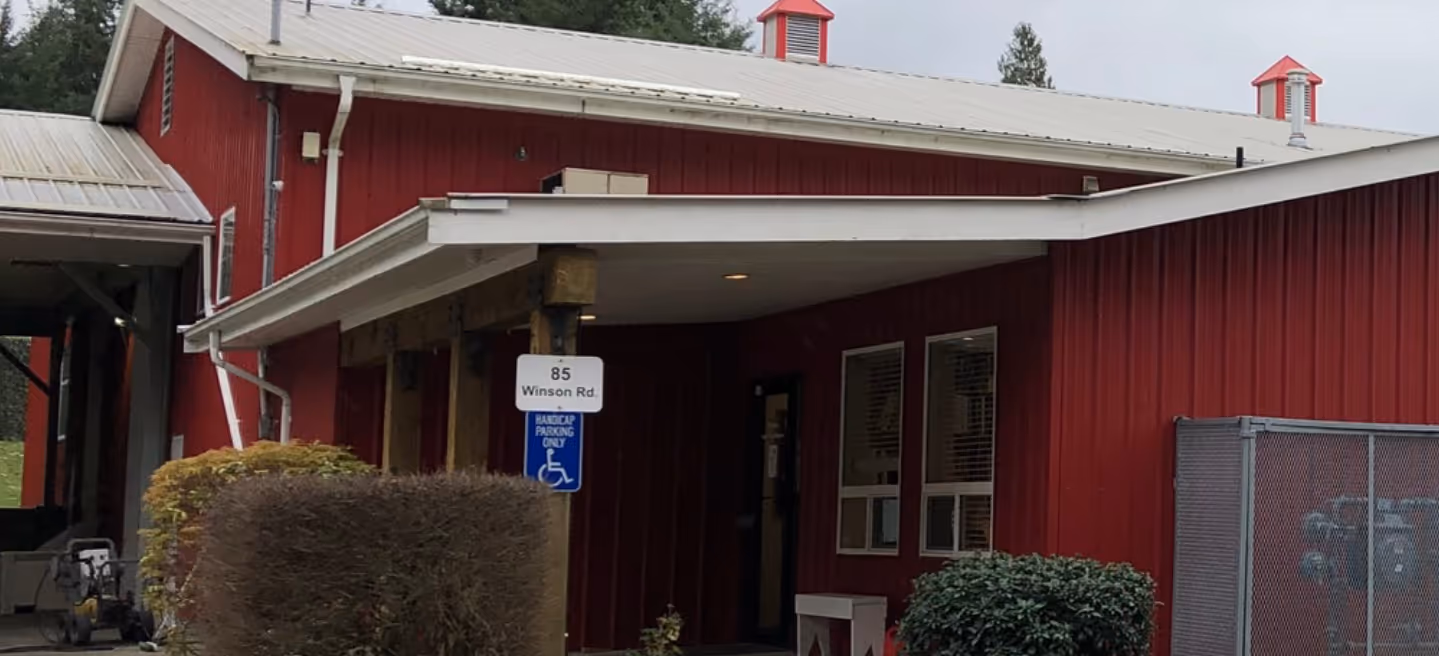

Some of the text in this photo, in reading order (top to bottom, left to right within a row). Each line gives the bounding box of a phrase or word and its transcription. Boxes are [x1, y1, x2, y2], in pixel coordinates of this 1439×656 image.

[551, 367, 571, 381] 85
[521, 385, 572, 397] Winson
[535, 414, 576, 425] HANDICAP
[535, 426, 575, 437] PARKING
[542, 437, 566, 448] ONLY
